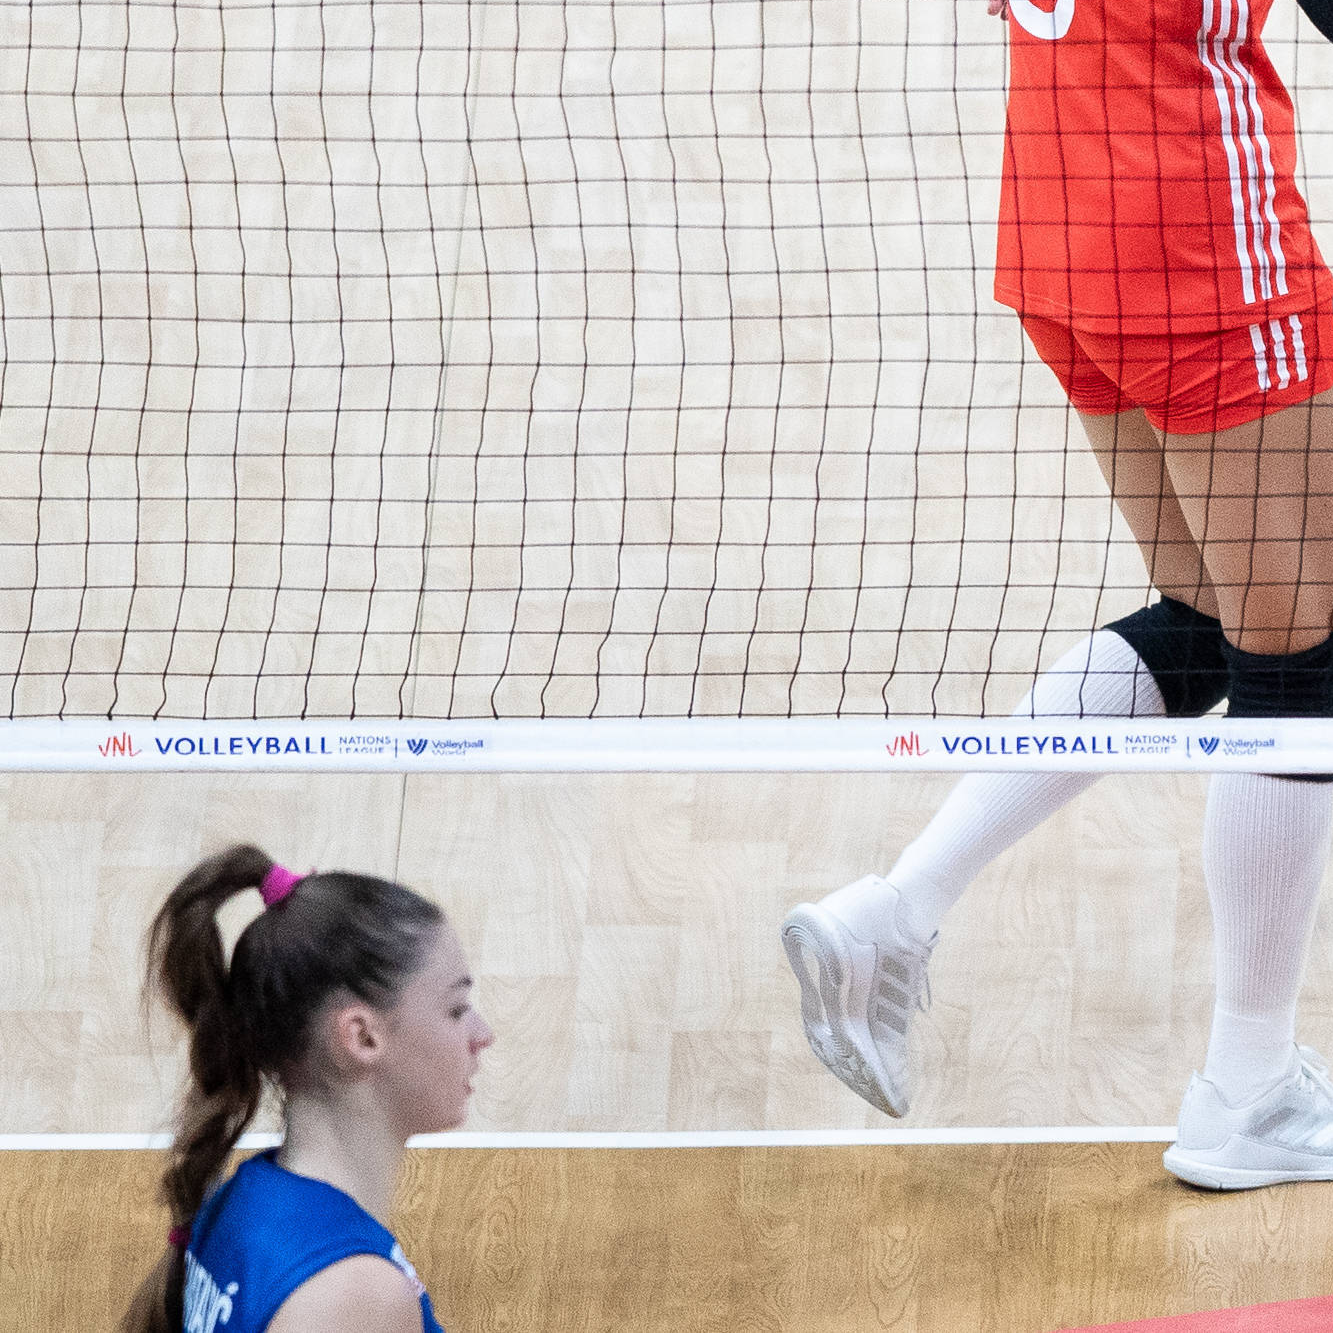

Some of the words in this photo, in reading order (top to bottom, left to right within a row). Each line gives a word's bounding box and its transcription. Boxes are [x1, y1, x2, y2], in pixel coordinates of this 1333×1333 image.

[98, 732, 142, 757] VNL
[155, 736, 333, 755] VOLLEYBALL
[339, 736, 391, 745] NATIONS
[432, 738, 484, 750] Volleyball
[886, 731, 929, 756] VNL
[942, 735, 1118, 754] VOLLEYBALL
[1125, 735, 1177, 744] NATIONS
[1223, 738, 1275, 749] Volleyball
